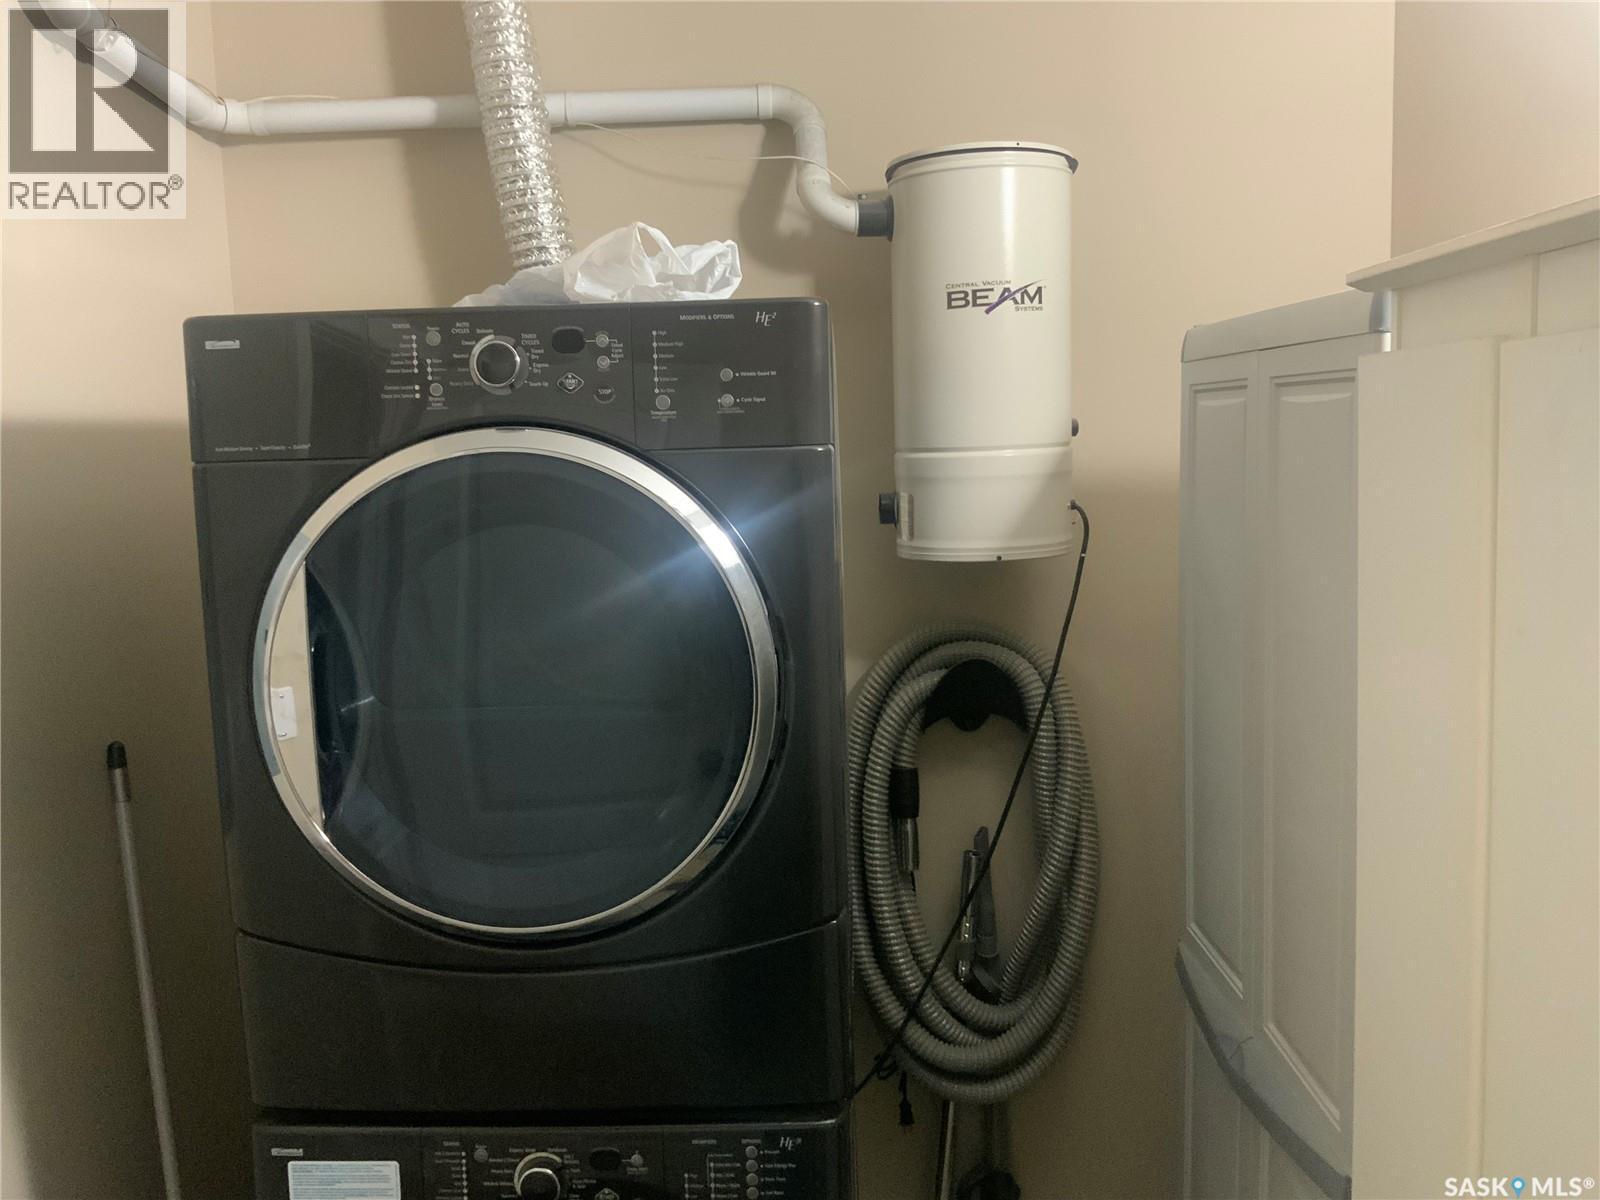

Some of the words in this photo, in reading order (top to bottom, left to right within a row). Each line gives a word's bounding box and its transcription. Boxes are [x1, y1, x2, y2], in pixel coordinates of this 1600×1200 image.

[945, 282, 978, 290] CENTRAL
[982, 279, 1012, 287] VACUUM
[946, 285, 1043, 311] BEAM
